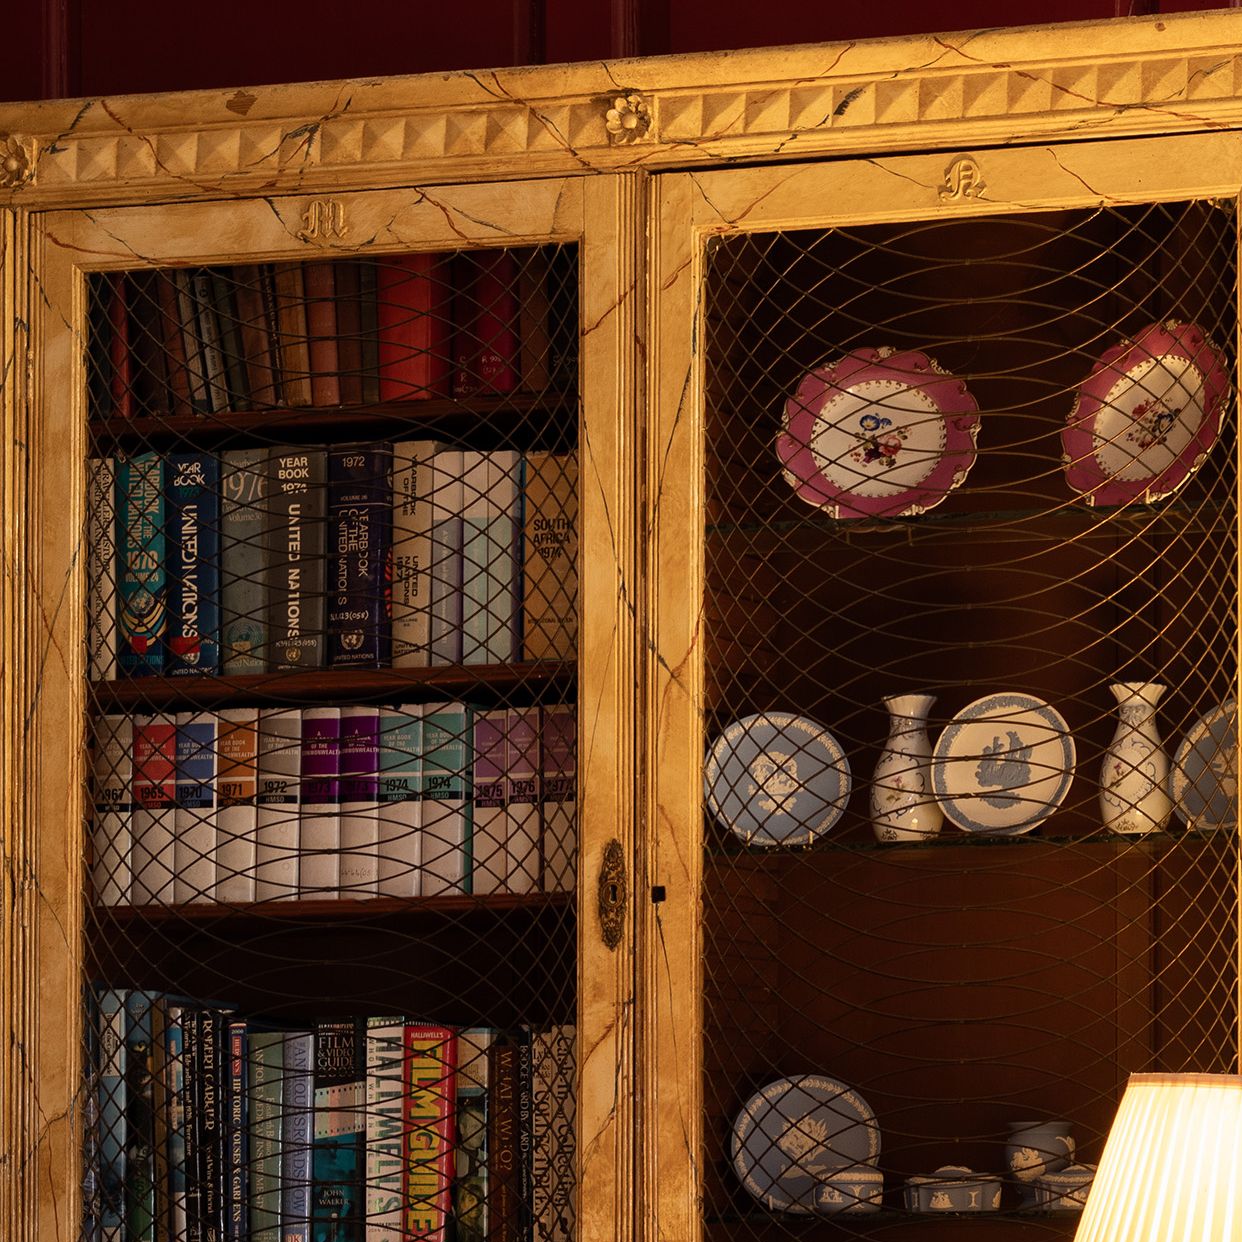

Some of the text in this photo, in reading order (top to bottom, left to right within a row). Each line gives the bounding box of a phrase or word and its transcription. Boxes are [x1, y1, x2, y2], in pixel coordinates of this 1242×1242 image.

[278, 457, 308, 467] YEAR
[342, 456, 366, 468] 1972
[278, 468, 309, 478] BOOK
[534, 519, 570, 531] SOUTH
[358, 508, 368, 577] YEARBOOK
[534, 532, 570, 544] AFRICA
[288, 504, 300, 640] UNITED NATIONS
[386, 780, 408, 791] 1974
[428, 776, 451, 788] 1974
[222, 784, 242, 796] 1971
[318, 1038, 354, 1048] FILM
[318, 1058, 354, 1067] GUIDE
[406, 1040, 444, 1232] FILM GUIDE
